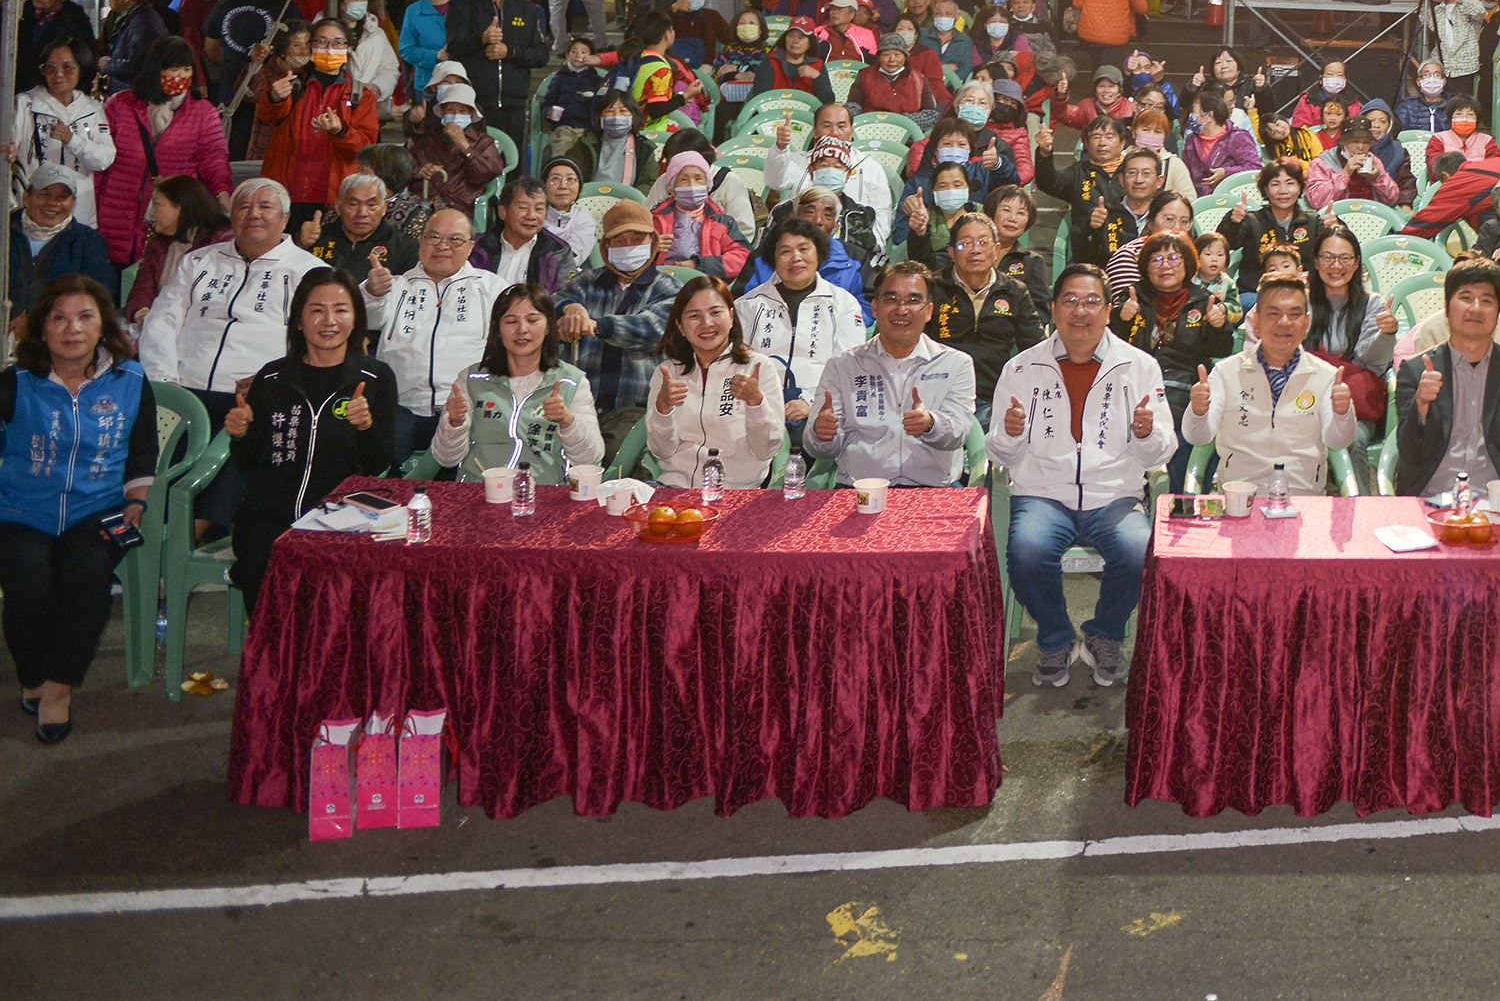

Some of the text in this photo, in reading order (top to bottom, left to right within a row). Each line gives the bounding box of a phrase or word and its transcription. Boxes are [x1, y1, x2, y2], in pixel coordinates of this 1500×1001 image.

[854, 375, 868, 418] 李貴富
[1042, 389, 1054, 439] 陳仁杰
